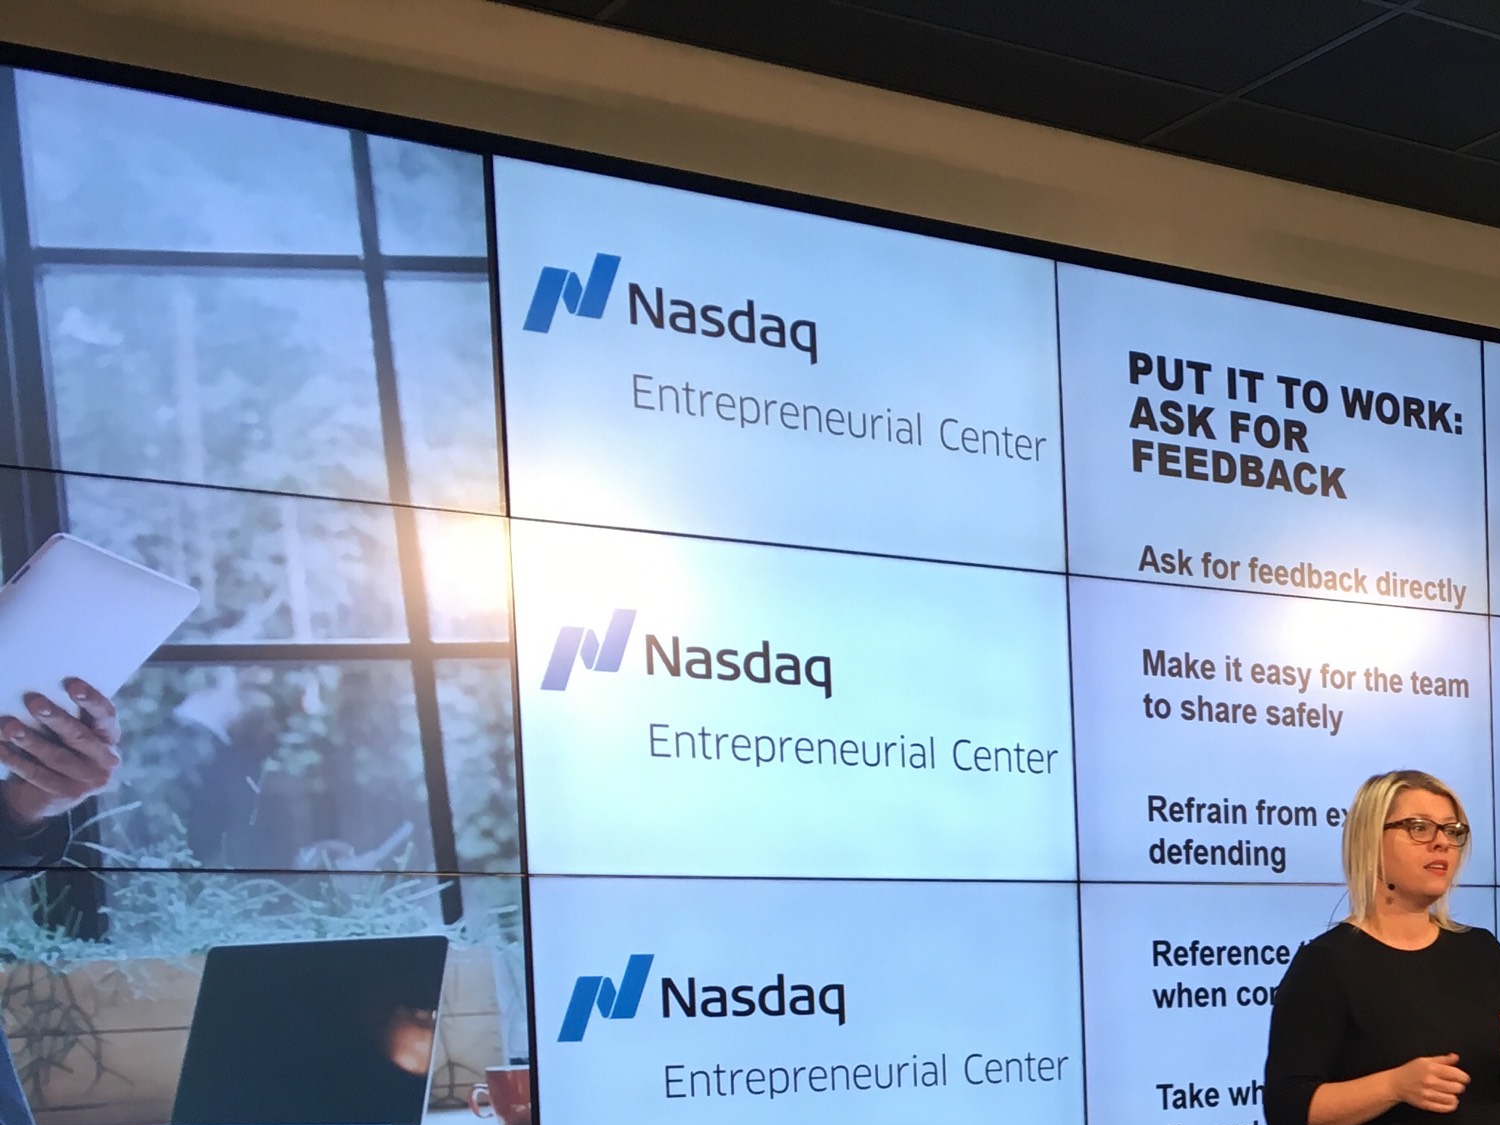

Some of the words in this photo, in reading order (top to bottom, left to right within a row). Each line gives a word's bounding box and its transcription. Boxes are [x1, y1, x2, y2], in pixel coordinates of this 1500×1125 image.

[629, 283, 818, 364] Nasdaq
[632, 374, 922, 446] Entrepreneurial
[940, 418, 1046, 462] Center
[1129, 351, 1210, 394] PUT
[1227, 367, 1264, 402] IT
[1277, 375, 1328, 413] TO
[1341, 385, 1462, 434] WORK:
[1130, 397, 1217, 440] ASK
[1230, 411, 1308, 452] FOR
[1132, 439, 1347, 498] FEEDBACK
[1139, 545, 1192, 577] Ask
[1201, 552, 1240, 581] for
[1249, 557, 1367, 594] feedback
[1376, 570, 1466, 609] directly
[645, 634, 832, 698] Nasdaq
[1143, 649, 1215, 680] Make
[1226, 655, 1242, 682] it
[1251, 663, 1311, 692] easy
[1320, 663, 1356, 690] for
[1364, 667, 1402, 693] the
[1411, 671, 1469, 698] team
[1143, 693, 1171, 719] to
[1181, 695, 1257, 724] share
[1266, 701, 1343, 736] safely
[649, 723, 935, 768] Entrepreneurial
[952, 739, 1058, 774] Center
[1148, 796, 1247, 824] Refrain
[1256, 799, 1316, 826] from
[1149, 838, 1286, 873] defending
[1153, 940, 1290, 966] Reference
[662, 974, 845, 1025] Nasdaq
[1153, 982, 1227, 1008] when
[665, 1054, 946, 1099] Entrepreneurial
[964, 1051, 1068, 1085] Center
[1156, 1082, 1219, 1110] Take
